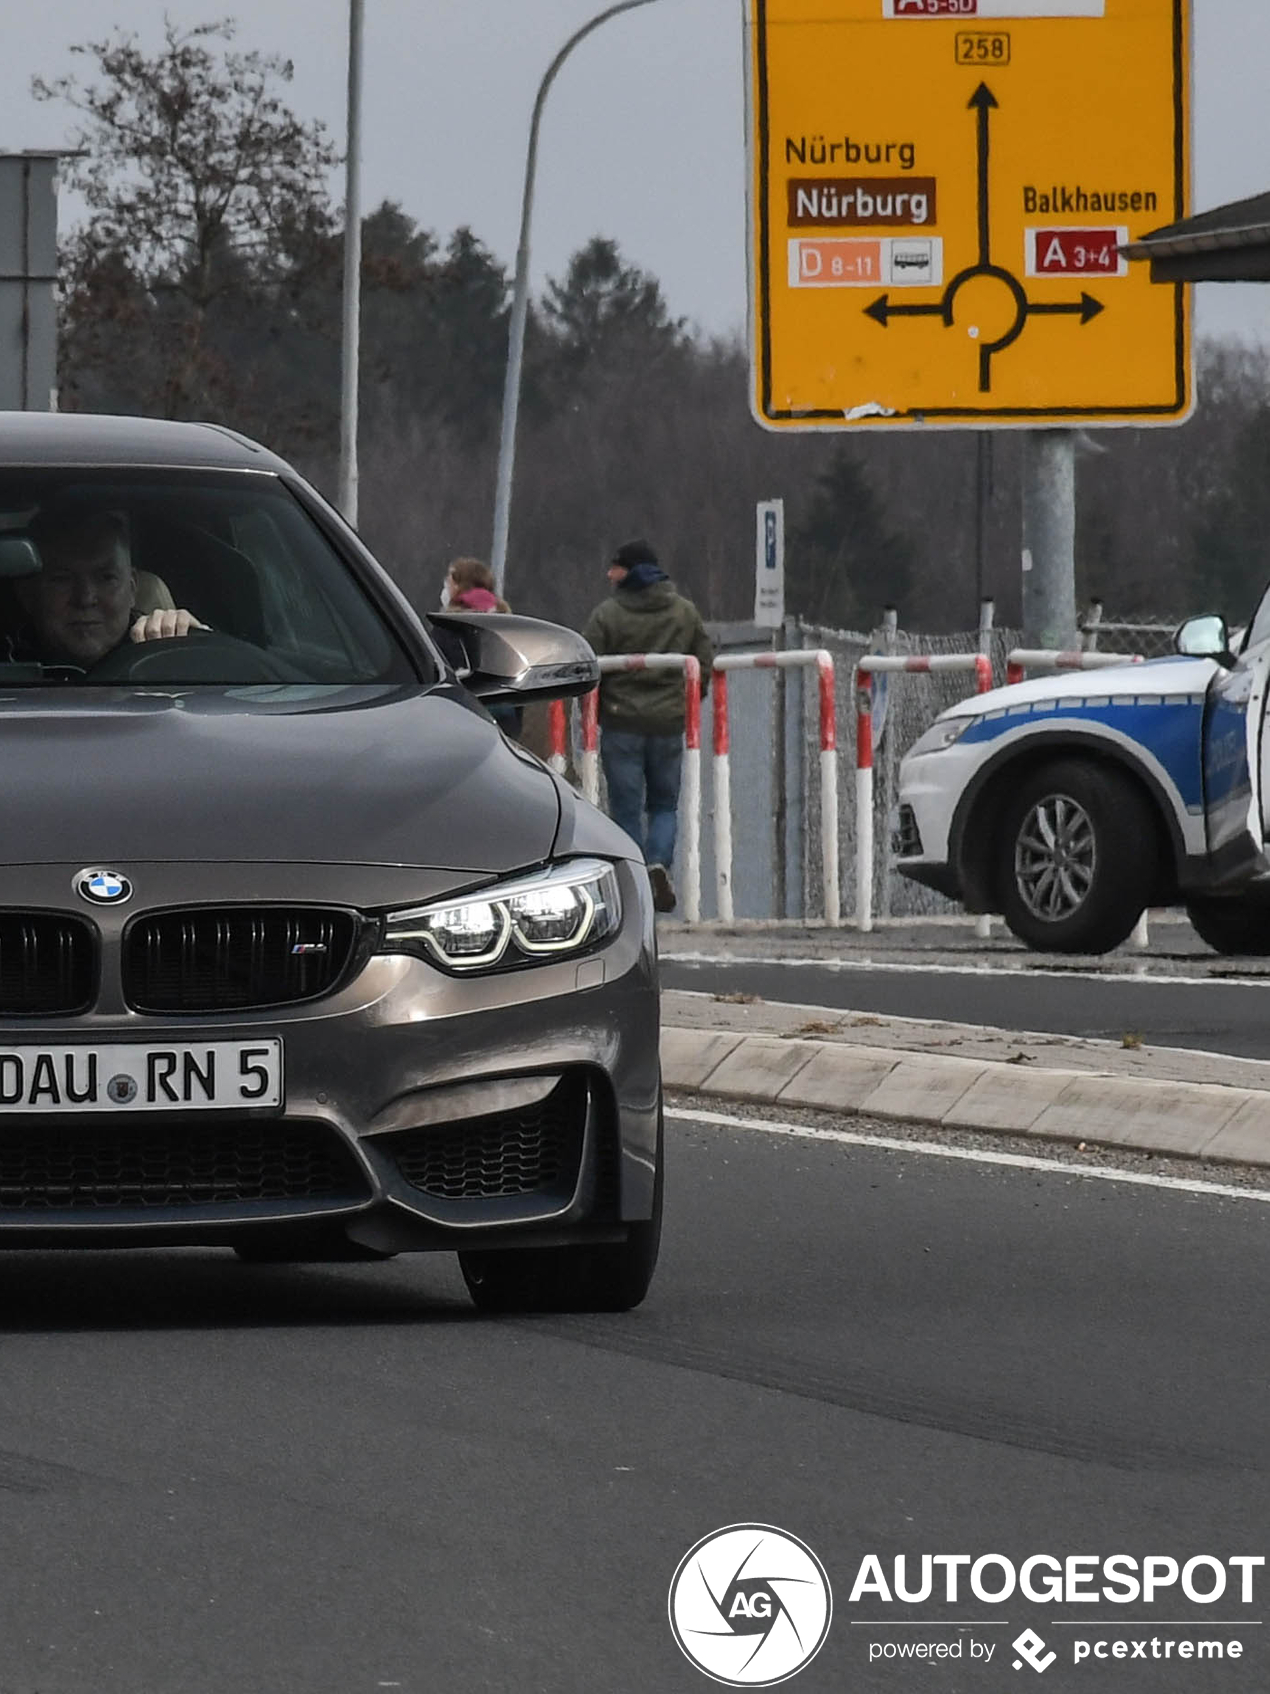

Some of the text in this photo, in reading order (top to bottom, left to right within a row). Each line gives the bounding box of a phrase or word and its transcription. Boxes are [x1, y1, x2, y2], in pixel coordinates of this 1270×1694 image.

[962, 38, 1005, 59] 258
[785, 136, 915, 170] Nürburg
[796, 187, 928, 223] Nürburg
[1023, 186, 1157, 213] Balkhausen
[801, 248, 872, 277] D 8-11
[1043, 237, 1110, 268] A 3+4
[147, 1050, 215, 1102] RN
[240, 1048, 269, 1098] 5
